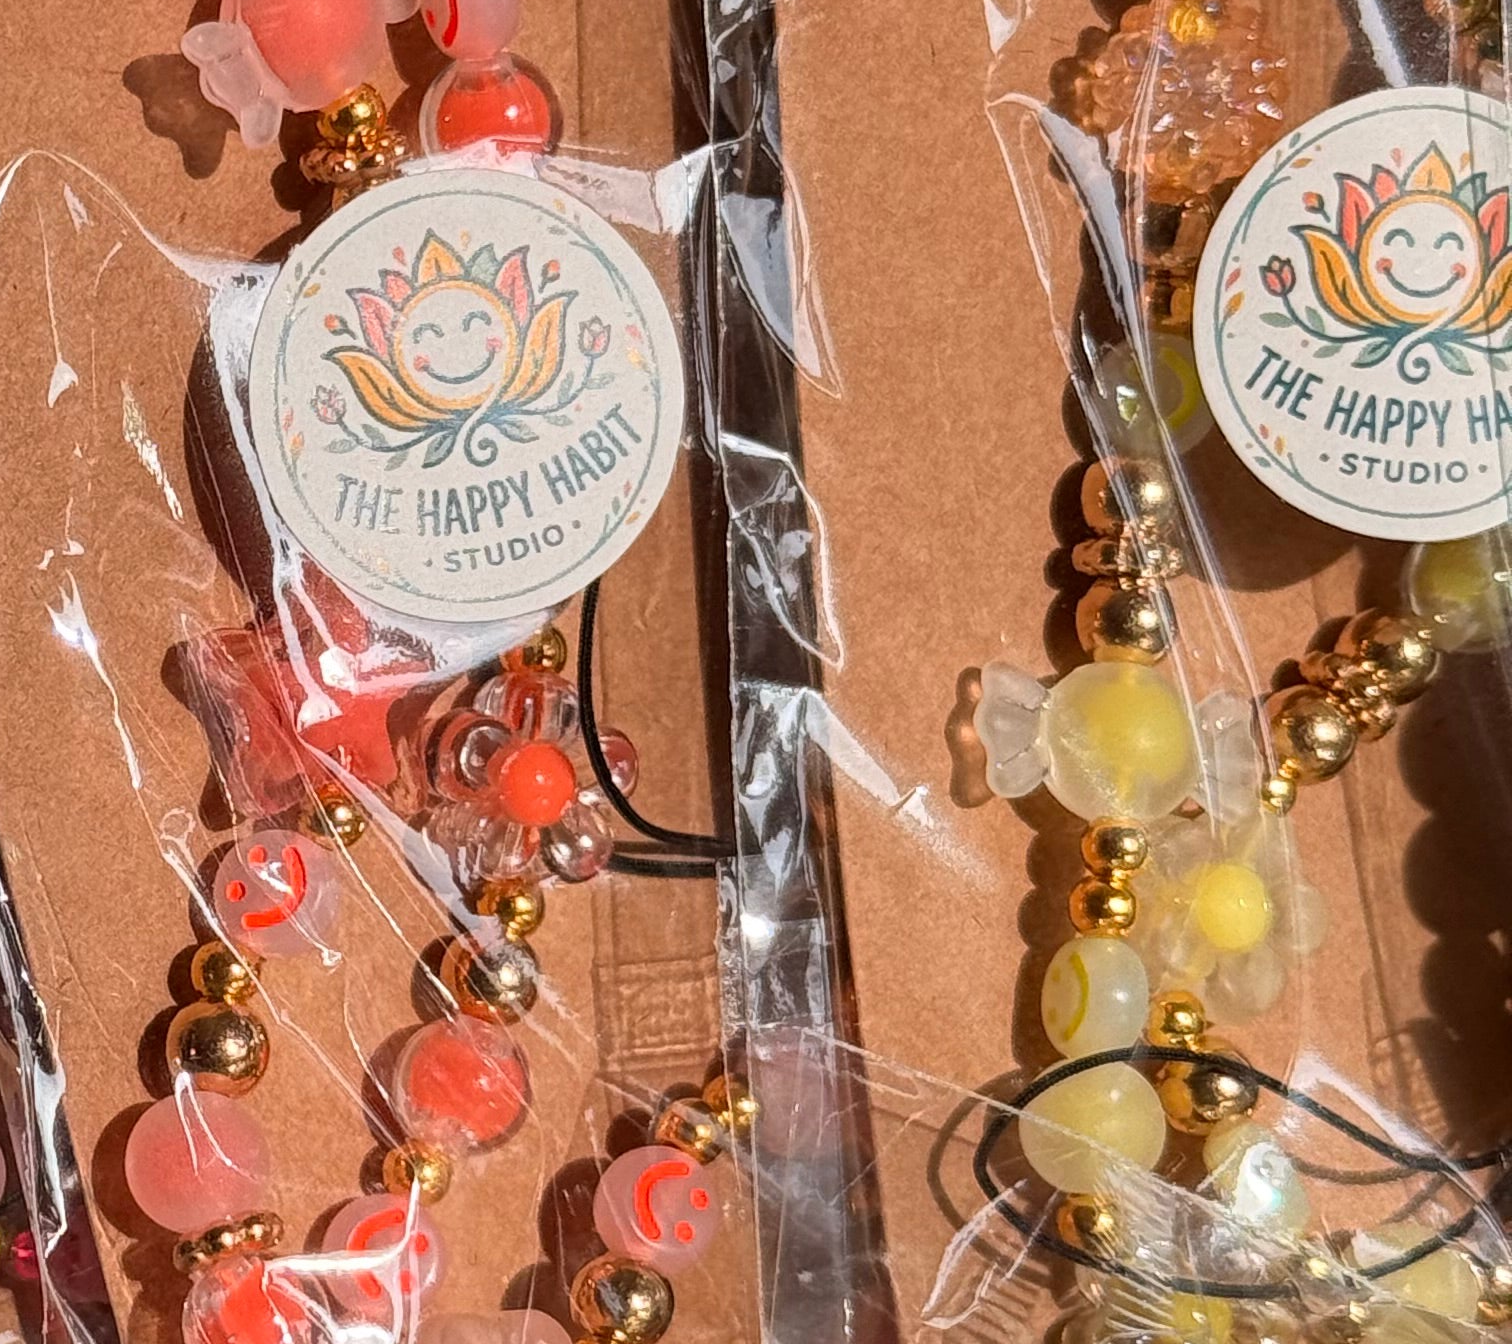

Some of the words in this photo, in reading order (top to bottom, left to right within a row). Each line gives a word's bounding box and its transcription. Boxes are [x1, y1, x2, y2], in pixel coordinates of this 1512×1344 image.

[1244, 345, 1324, 420] THE
[1324, 385, 1452, 448] HAPPY
[334, 473, 402, 536] THE
[417, 471, 534, 537] HAPPY
[543, 403, 642, 504] HABIT
[1338, 452, 1469, 485] STUDIO
[444, 525, 564, 572] STUDIO
